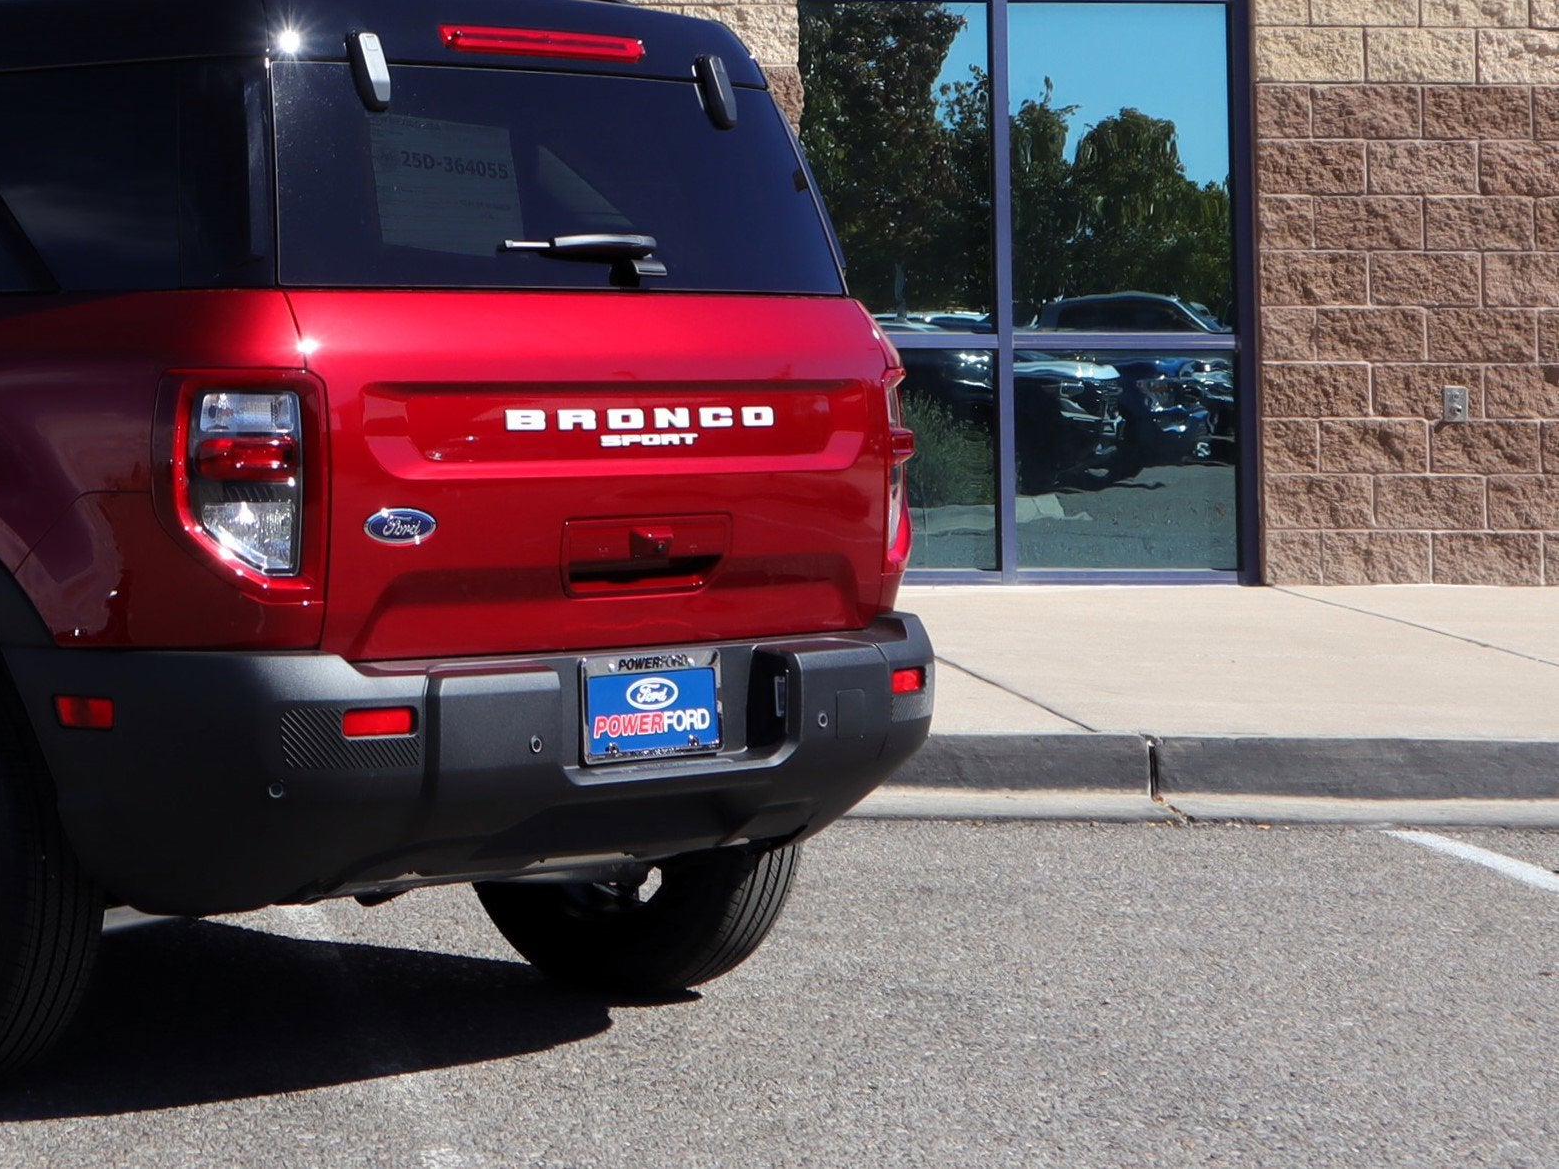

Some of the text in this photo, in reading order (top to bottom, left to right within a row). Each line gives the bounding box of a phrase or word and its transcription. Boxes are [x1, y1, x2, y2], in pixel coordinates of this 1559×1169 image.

[400, 151, 509, 179] 25D-364055
[504, 407, 774, 431] BRONCO
[600, 433, 698, 447] SPORT
[383, 516, 421, 536] Ford
[636, 683, 668, 704] Ford
